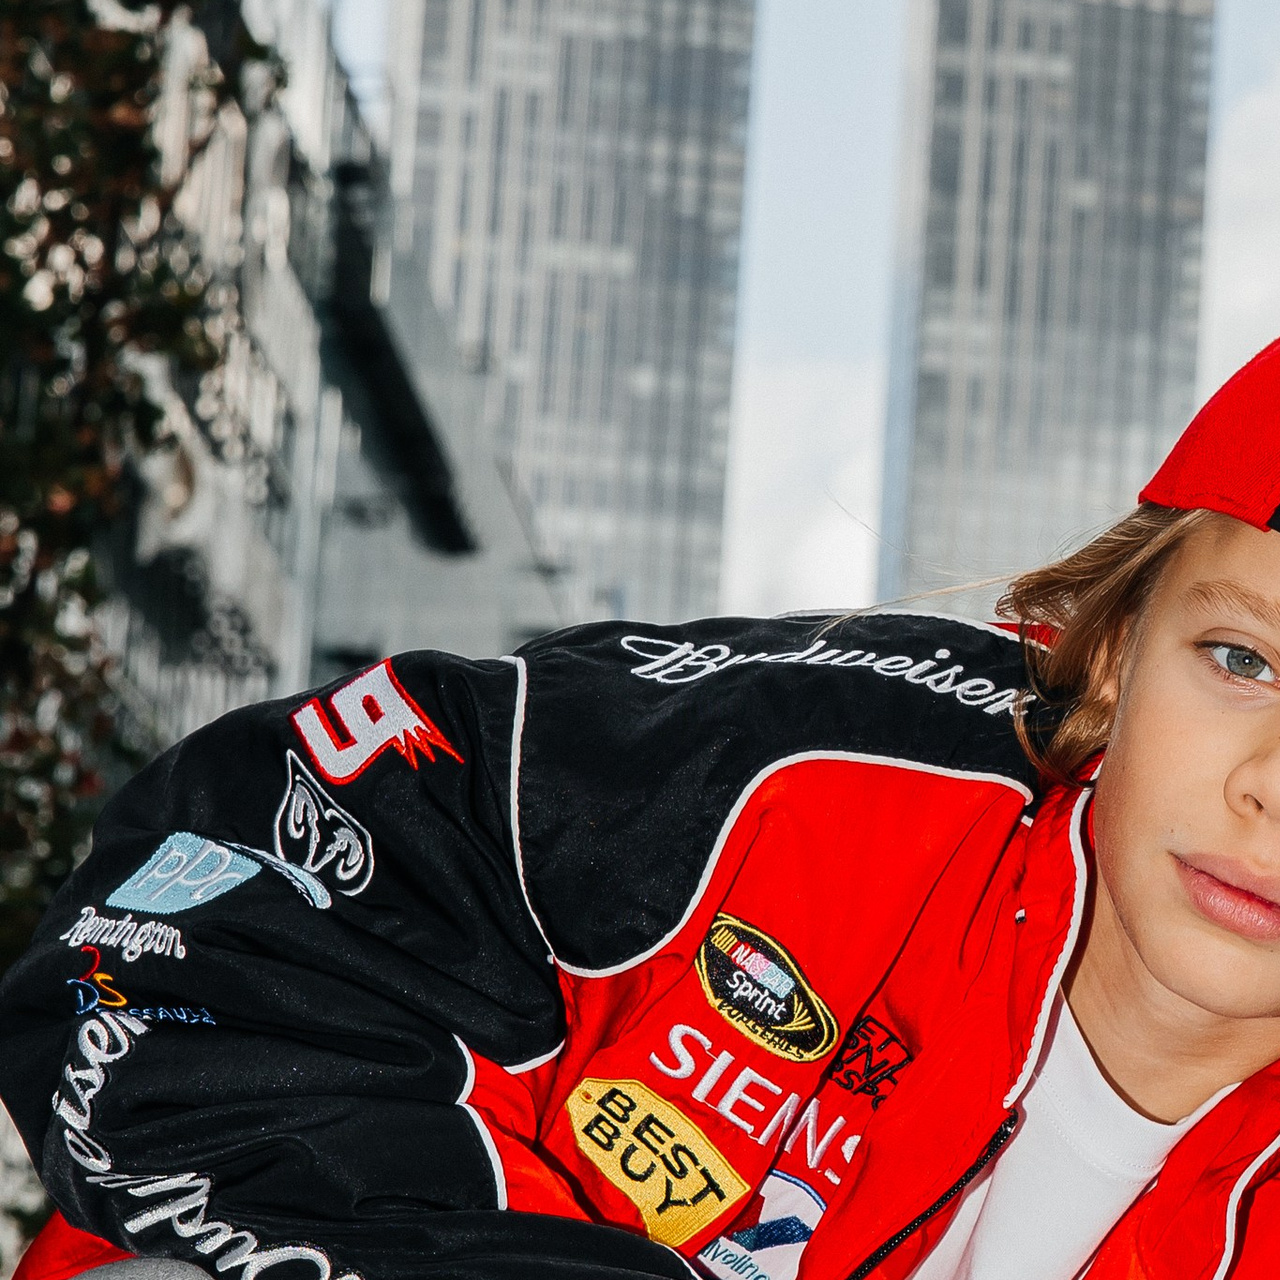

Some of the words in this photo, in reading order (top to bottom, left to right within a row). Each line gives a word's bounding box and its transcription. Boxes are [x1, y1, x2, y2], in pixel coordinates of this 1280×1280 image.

[288, 657, 465, 785] 9
[60, 906, 186, 962] Remington
[731, 943, 795, 998] NASCAR
[726, 971, 787, 1020] Sprint
[582, 1113, 692, 1216] BUY
[597, 1088, 727, 1206] BEST
